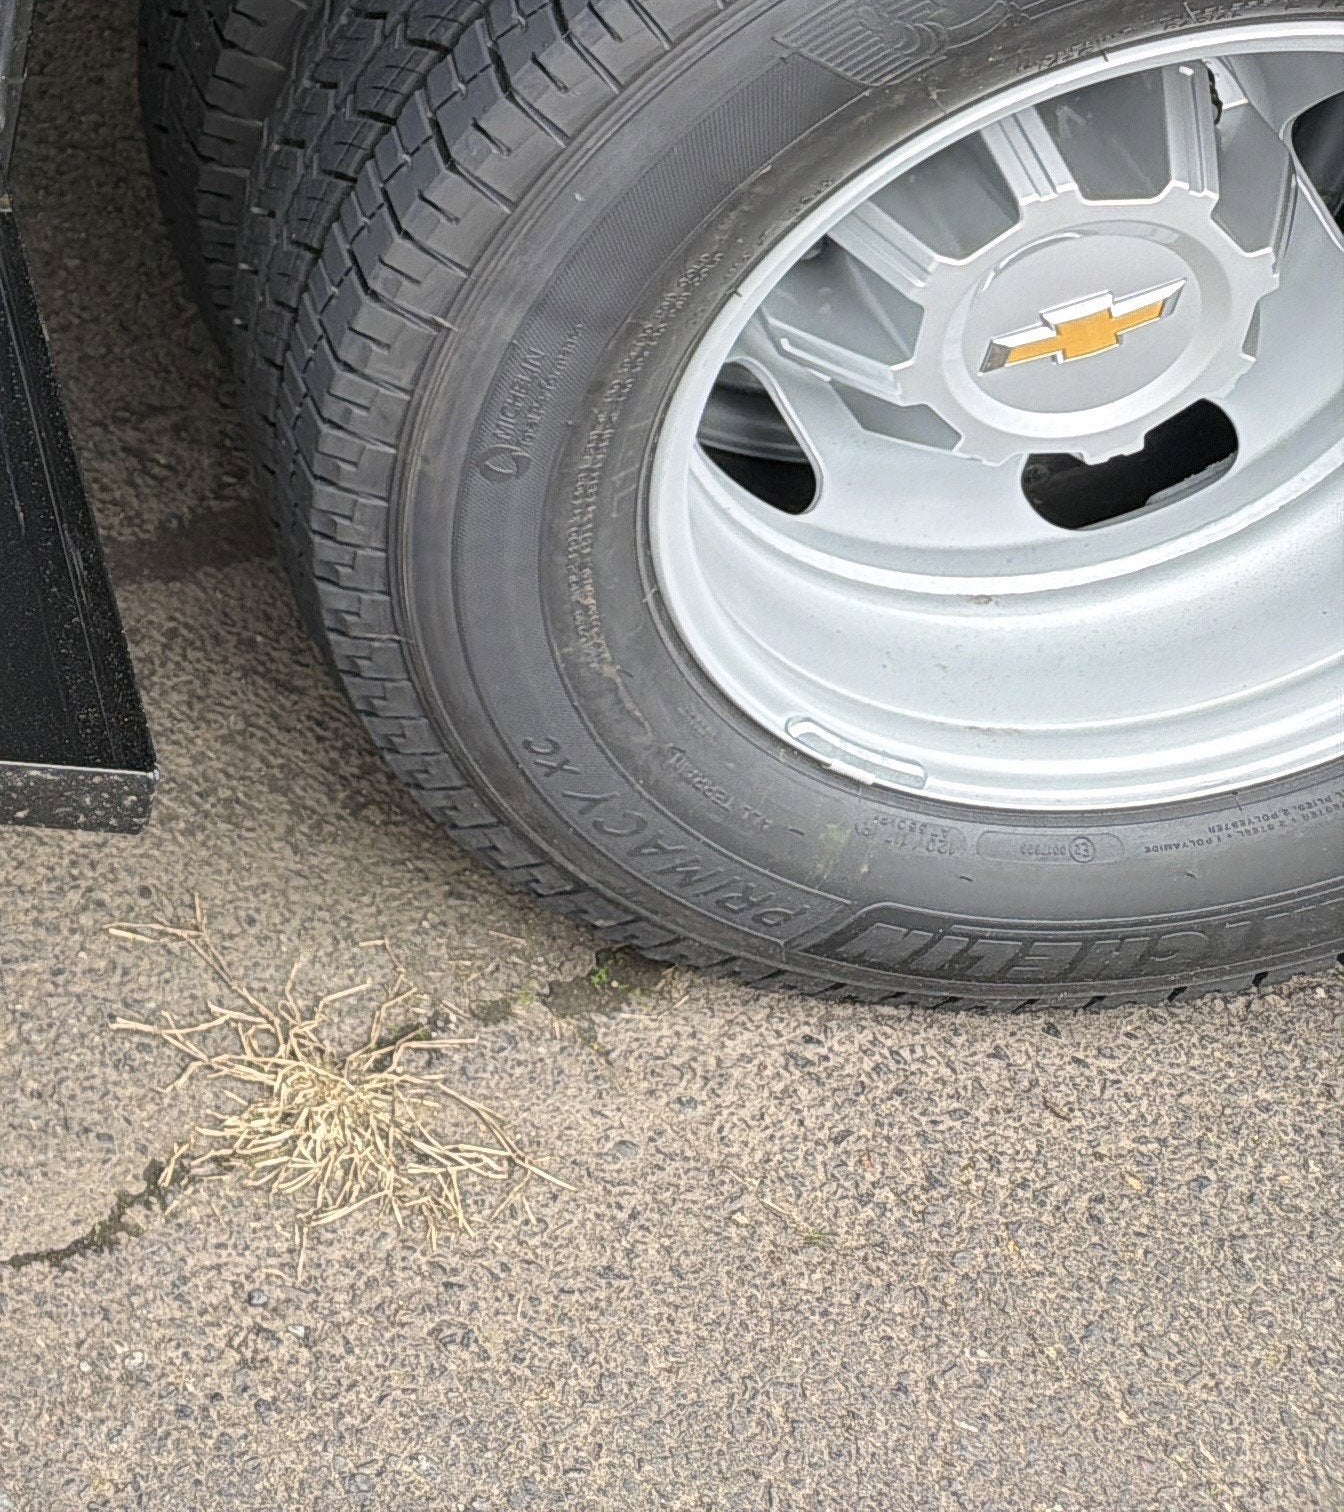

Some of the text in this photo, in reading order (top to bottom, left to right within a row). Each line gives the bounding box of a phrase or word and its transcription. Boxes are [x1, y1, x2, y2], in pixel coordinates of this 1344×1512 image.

[666, 743, 734, 813] TERRAIN
[520, 736, 811, 929] PRIMACY XC
[1145, 837, 1212, 854] POLYAMIDE
[1208, 813, 1278, 834] POLYESTER
